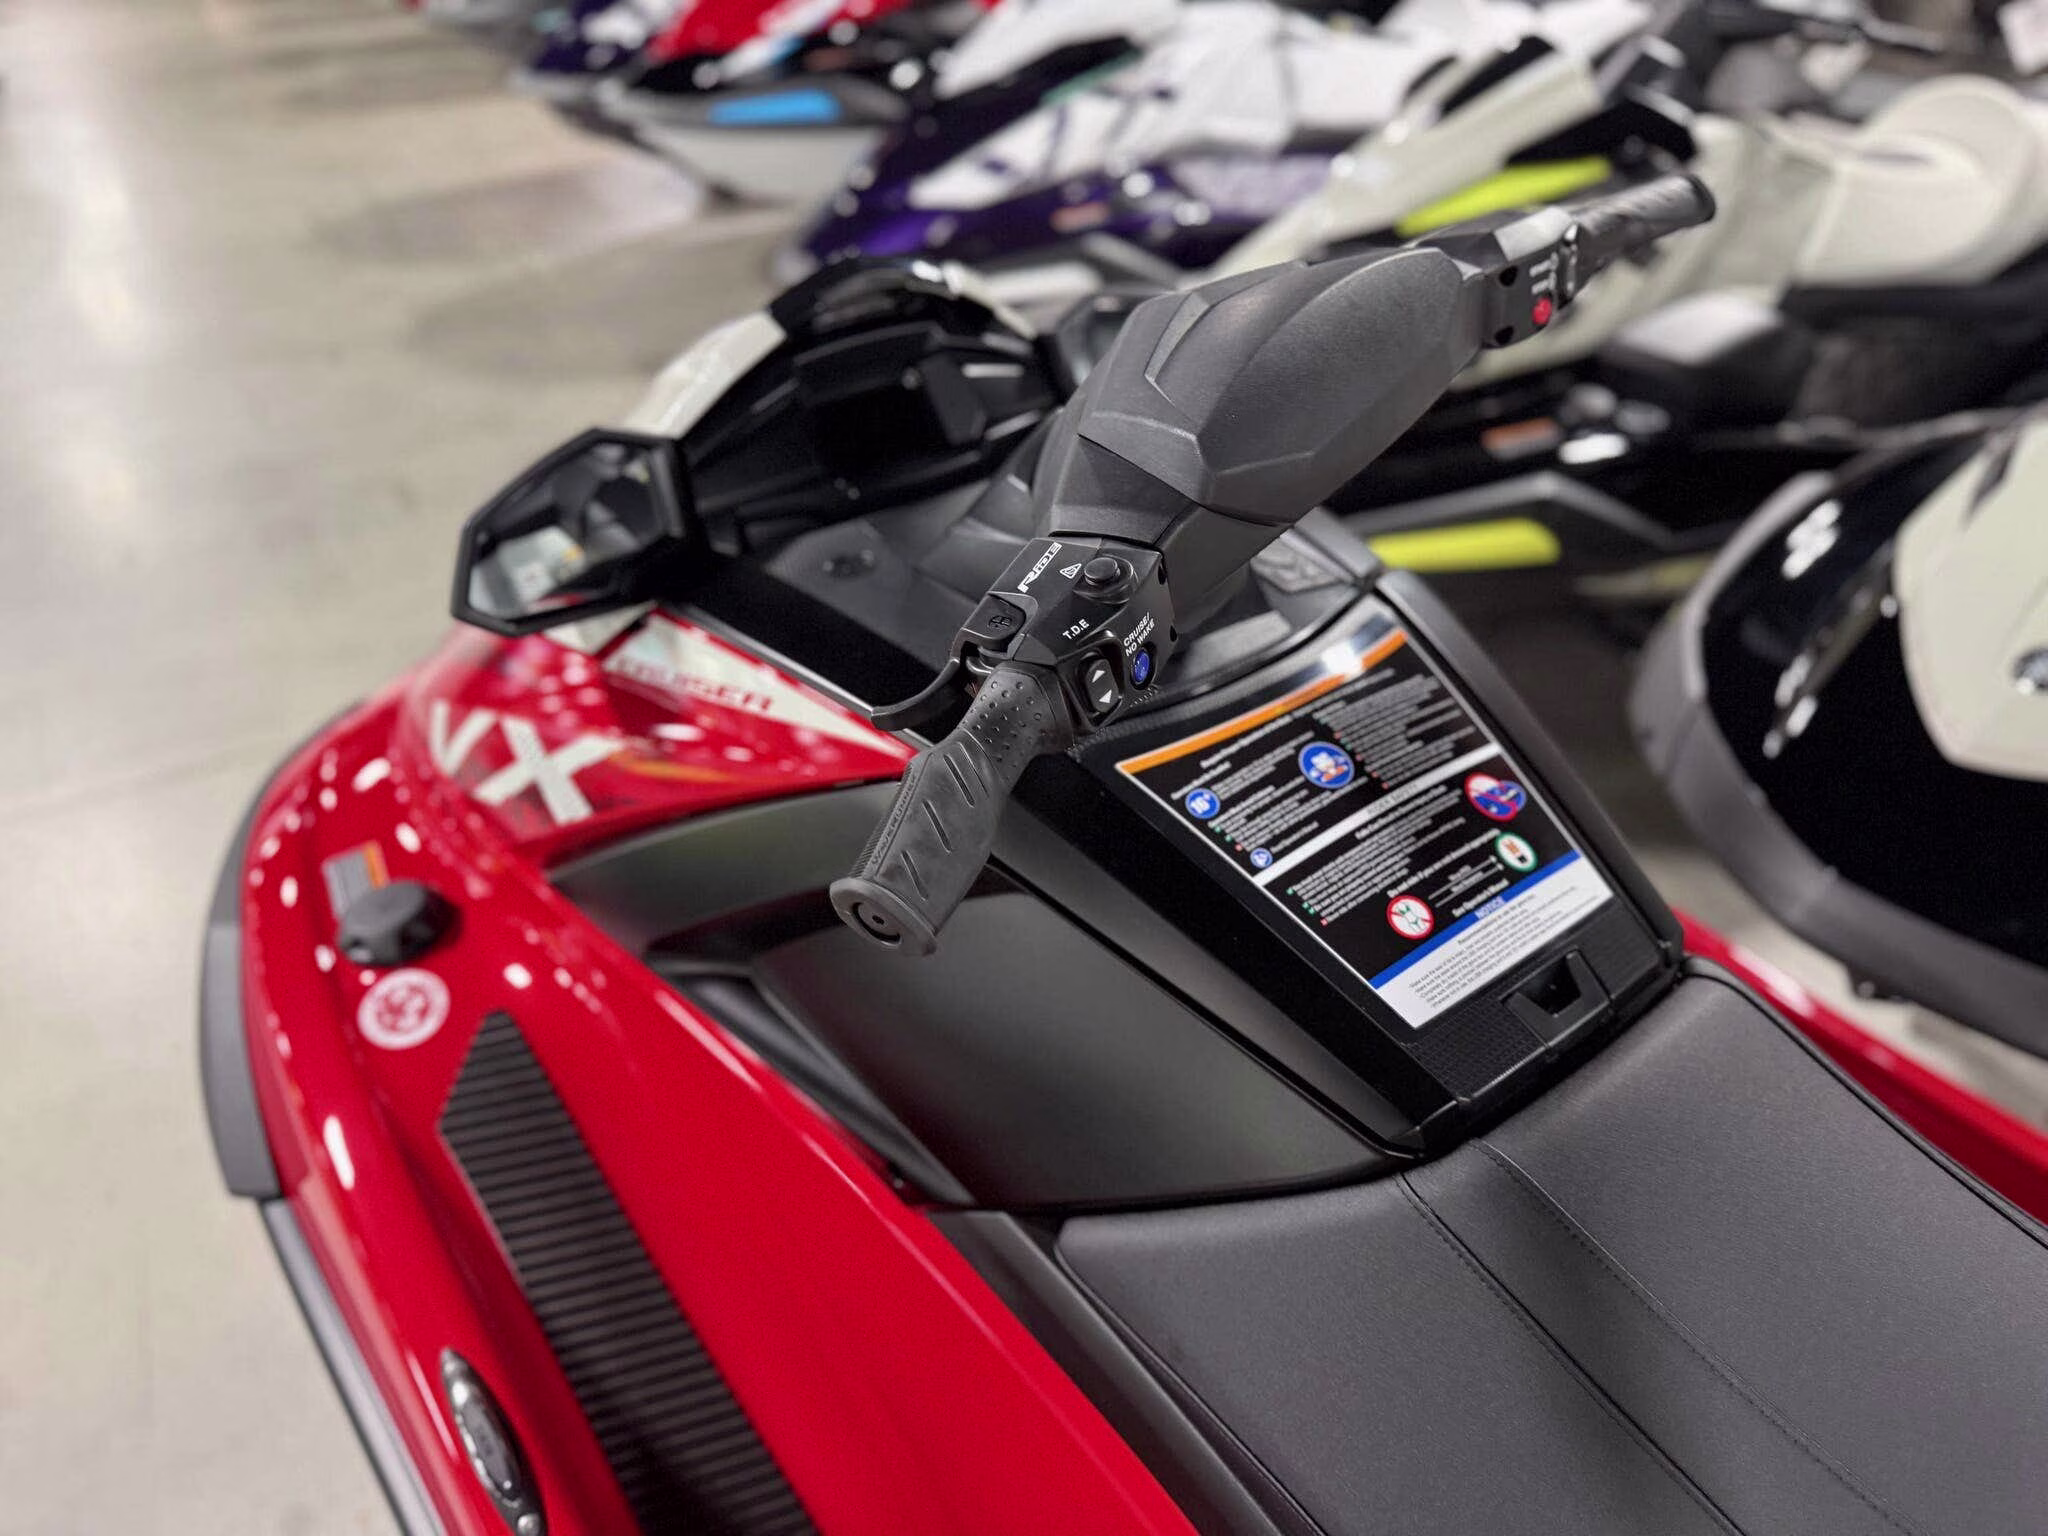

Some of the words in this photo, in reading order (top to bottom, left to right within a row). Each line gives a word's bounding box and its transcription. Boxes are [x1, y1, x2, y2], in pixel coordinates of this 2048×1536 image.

[1123, 611, 1150, 647] CRUISE/
[1125, 642, 1137, 656] NO
[1137, 618, 1155, 645] WAKE
[429, 698, 624, 825] VX
[1473, 895, 1507, 919] NOTICE
